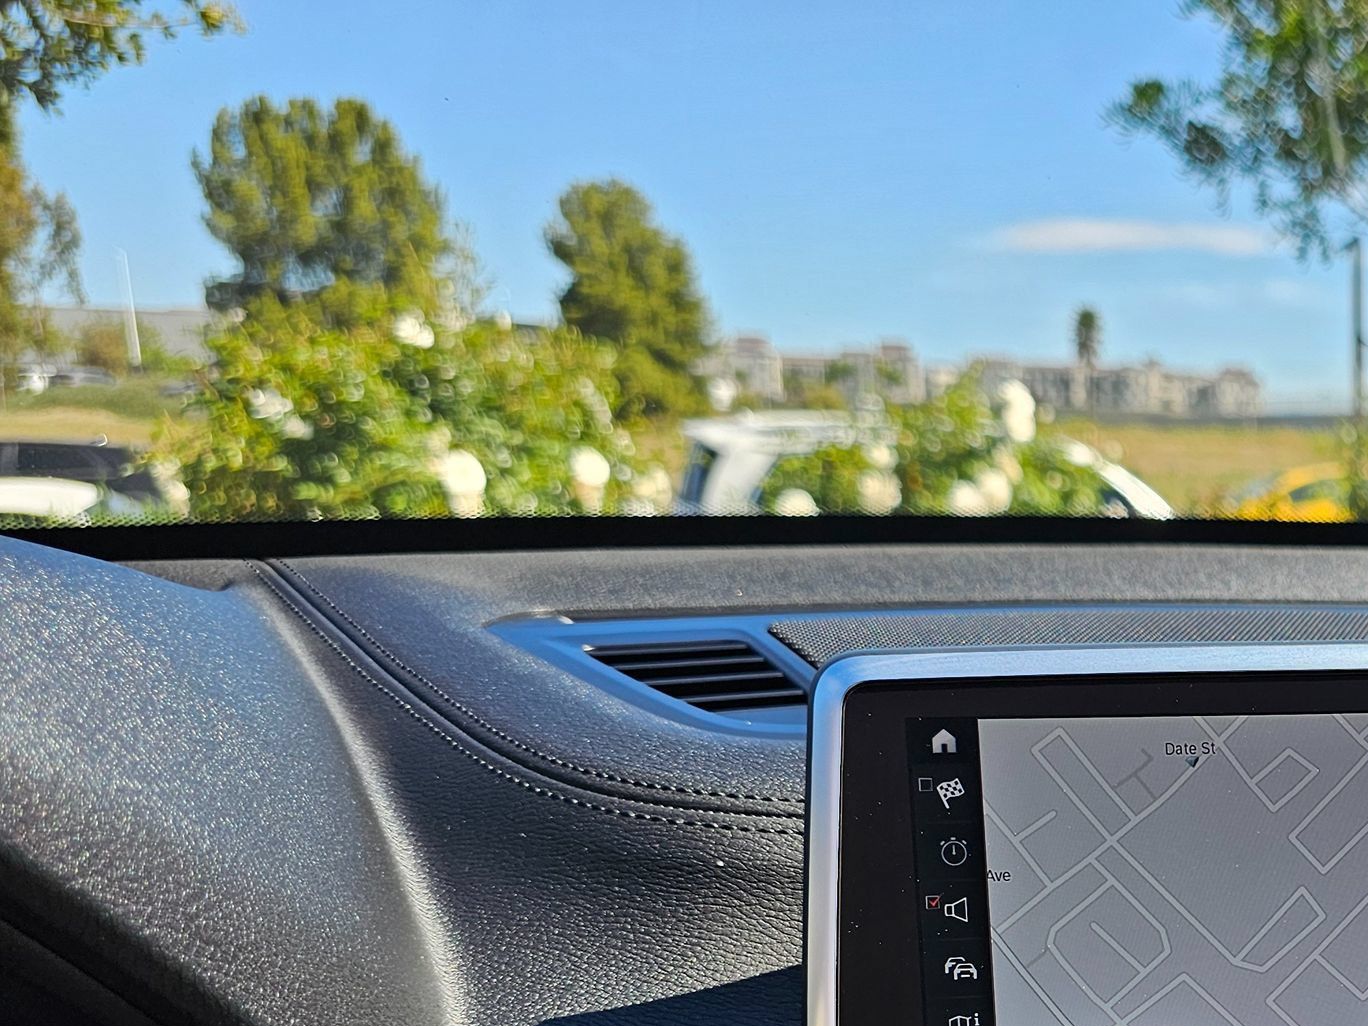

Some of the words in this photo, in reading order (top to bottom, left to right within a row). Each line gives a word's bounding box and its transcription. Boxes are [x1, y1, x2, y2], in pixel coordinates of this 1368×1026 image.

[1165, 742, 1197, 756] Date
[1201, 741, 1216, 755] St
[986, 869, 1011, 882] Ave
